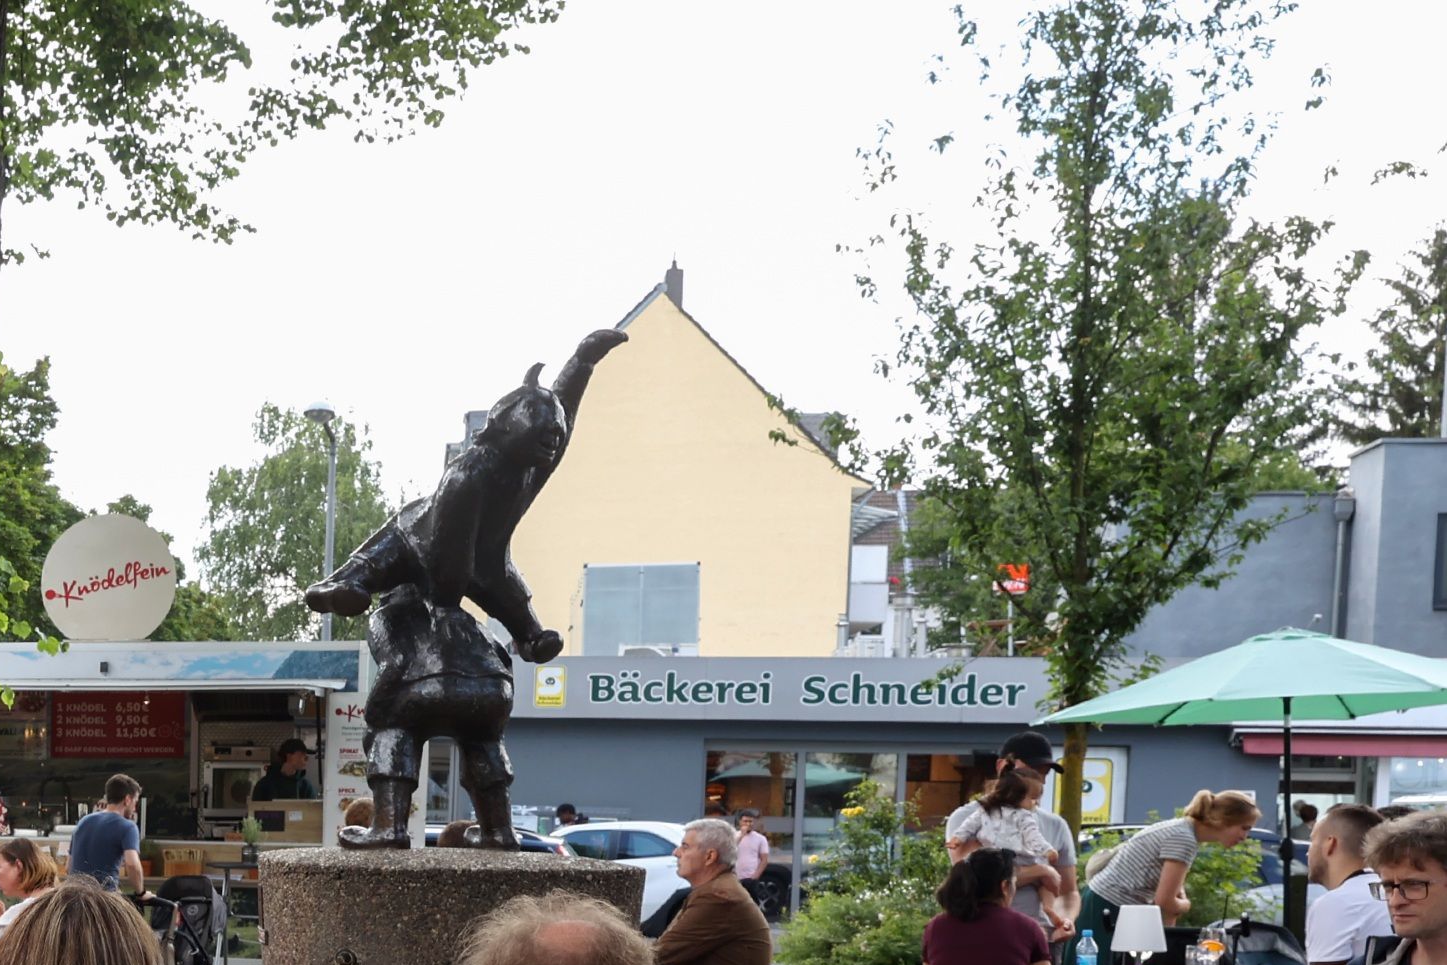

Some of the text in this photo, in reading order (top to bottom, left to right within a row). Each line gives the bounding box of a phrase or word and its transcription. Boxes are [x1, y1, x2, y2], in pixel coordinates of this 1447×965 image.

[62, 560, 171, 608] Knödelfein
[588, 671, 1027, 707] Bäckerei Schneider
[66, 702, 107, 713] KNÖDEL
[56, 715, 63, 725] 2
[66, 713, 107, 725] KNÖDEL
[56, 727, 63, 738] 3
[66, 726, 107, 738] KNÖDEL
